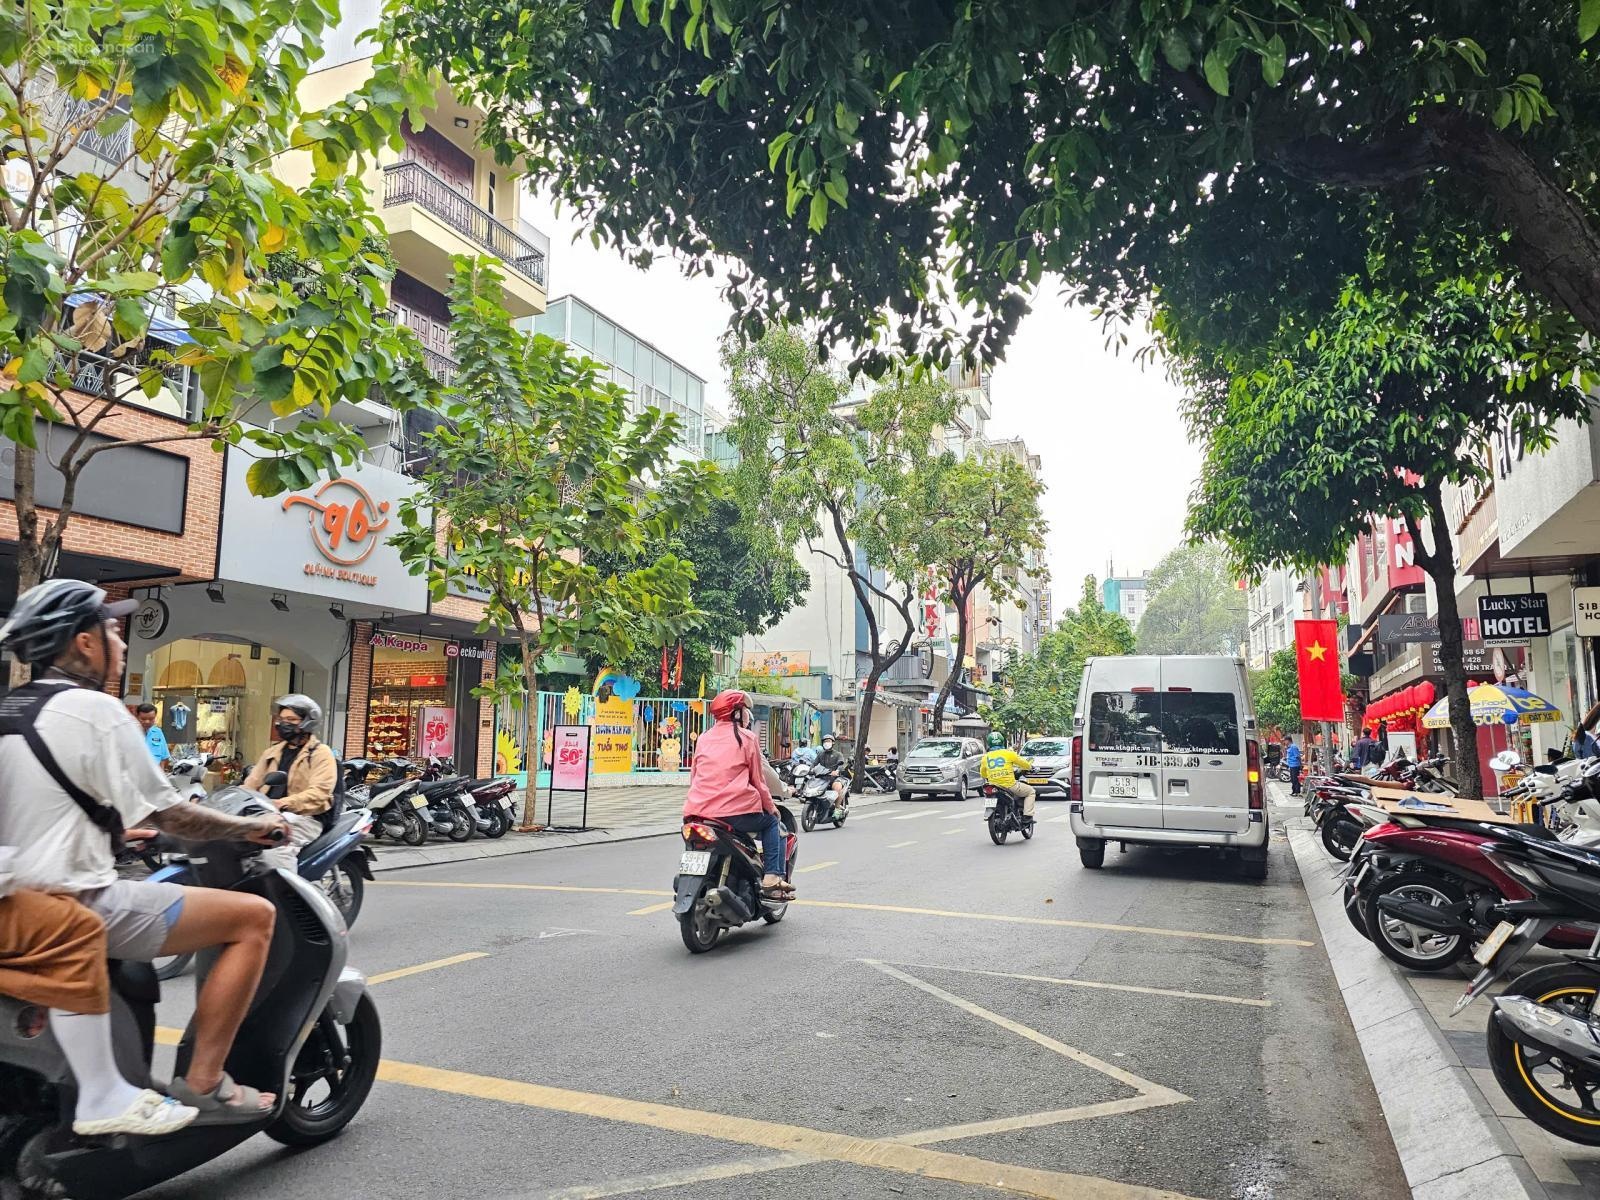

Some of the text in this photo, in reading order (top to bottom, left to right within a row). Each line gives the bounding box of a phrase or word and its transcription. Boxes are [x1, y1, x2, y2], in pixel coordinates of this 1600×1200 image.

[1482, 596, 1545, 612] Lucky Star
[1484, 617, 1549, 636] HOTEL
[386, 634, 429, 651] Kappa
[1507, 694, 1547, 710] be
[1472, 713, 1506, 726] 50K
[987, 756, 1005, 769] be
